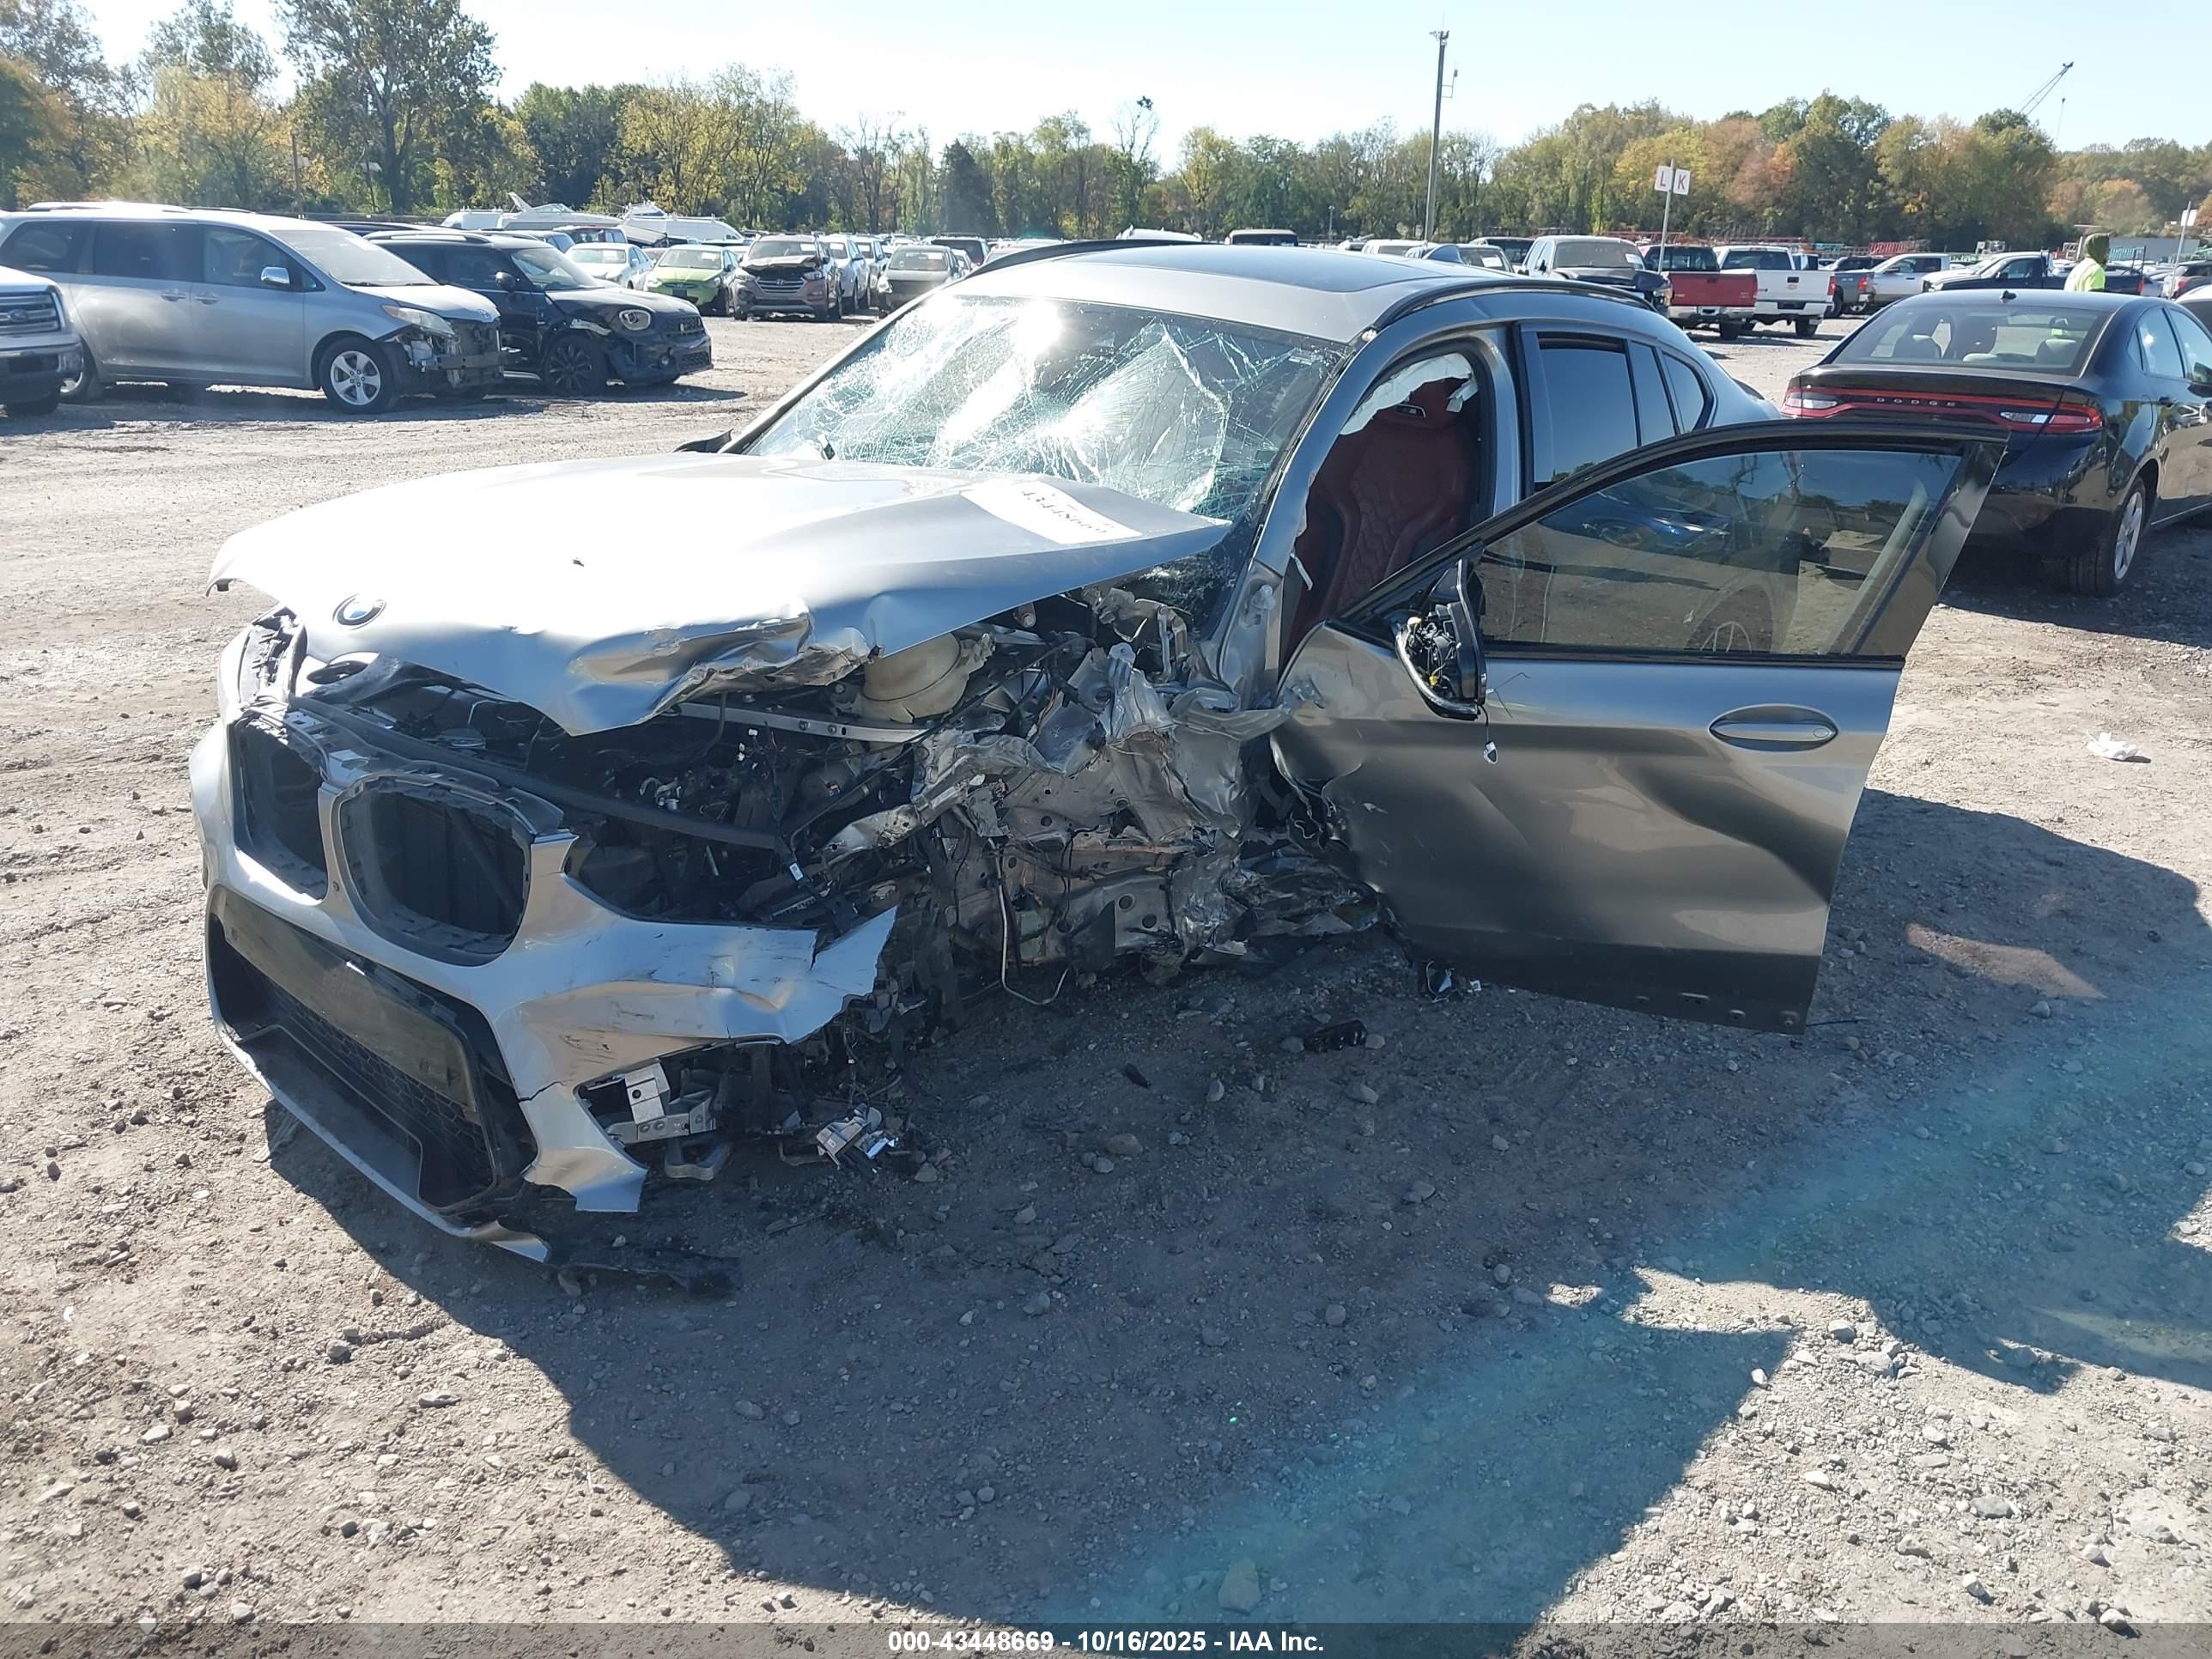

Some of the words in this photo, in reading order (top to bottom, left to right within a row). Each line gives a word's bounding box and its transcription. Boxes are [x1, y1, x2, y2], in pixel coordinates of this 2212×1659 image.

[1660, 171, 1666, 186] L
[1677, 174, 1686, 190] K
[1876, 398, 1955, 407] DODGE
